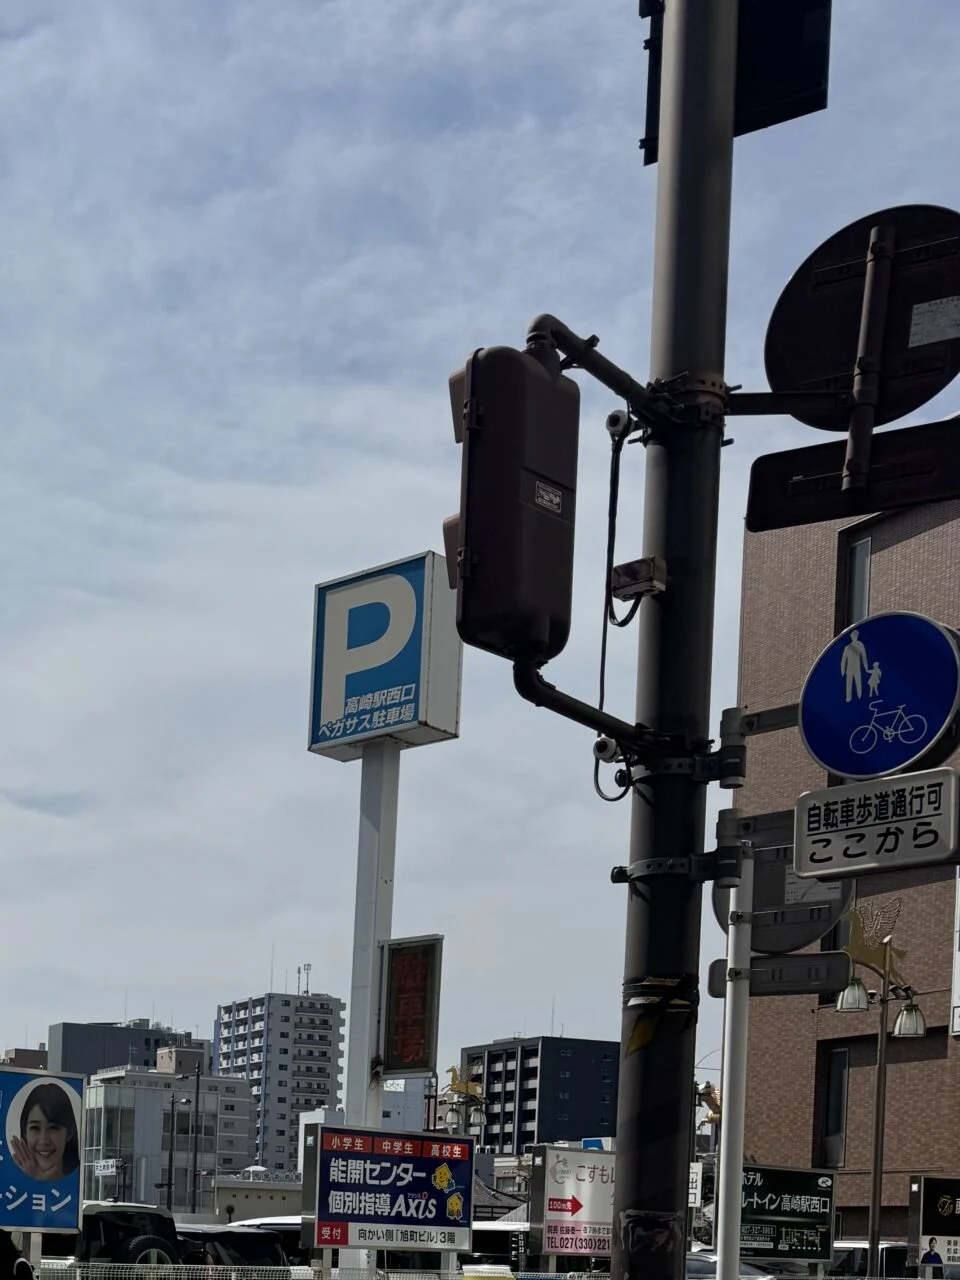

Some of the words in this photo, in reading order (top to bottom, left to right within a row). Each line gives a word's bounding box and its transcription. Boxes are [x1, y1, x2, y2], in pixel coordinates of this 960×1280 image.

[320, 573, 417, 726] P
[345, 683, 417, 715] 高崎駅西口
[318, 703, 416, 738] ペガサス駐車場
[807, 781, 944, 832] 自転車歩道通行可
[809, 821, 939, 864] ここから
[331, 1136, 364, 1151] 小学生
[382, 1141, 414, 1154] 中学生
[431, 1144, 462, 1158] 高校生
[329, 1157, 427, 1186] 能開センター
[321, 1227, 341, 1240] 受付
